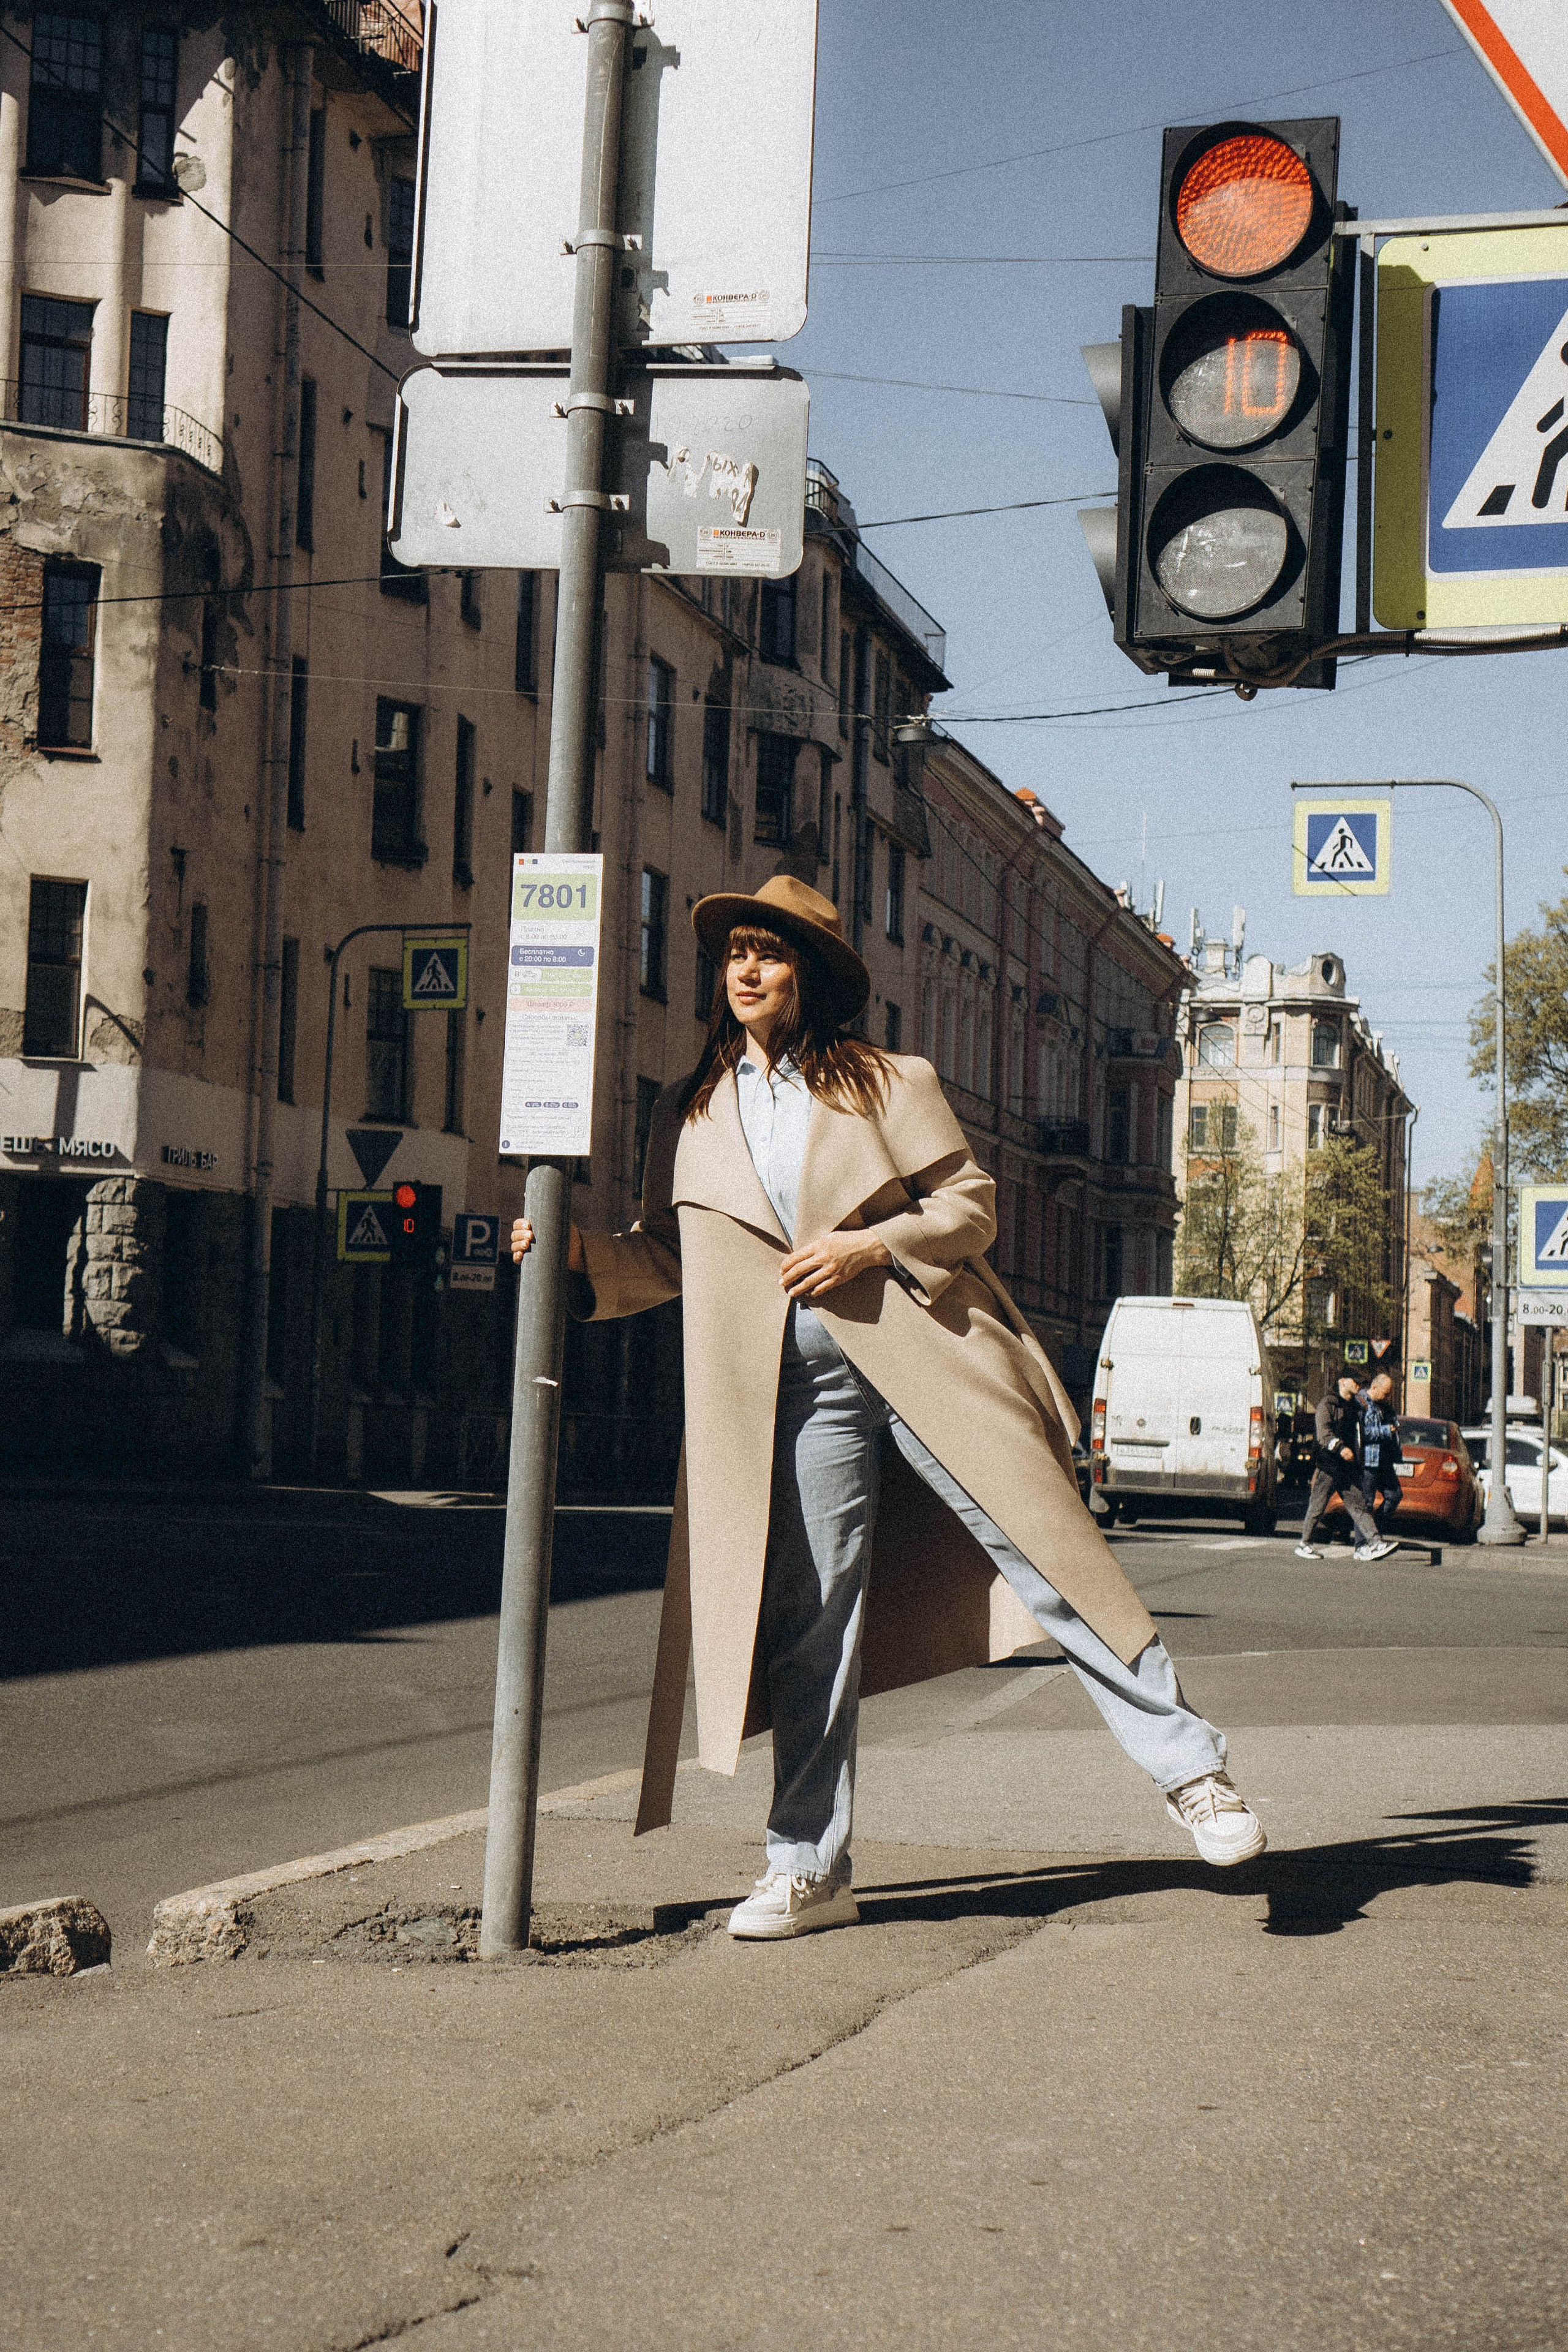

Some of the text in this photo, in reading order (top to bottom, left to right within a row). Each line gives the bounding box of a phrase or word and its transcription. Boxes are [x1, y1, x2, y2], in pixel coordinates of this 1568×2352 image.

[1224, 331, 1287, 416] 10
[521, 884, 587, 908] 7801
[59, 1137, 115, 1158] МЯСО
[202, 1151, 218, 1170] БАР
[403, 1218, 415, 1233] 10
[466, 1219, 490, 1256] P
[1523, 1303, 1568, 1315] 8.00-20.
